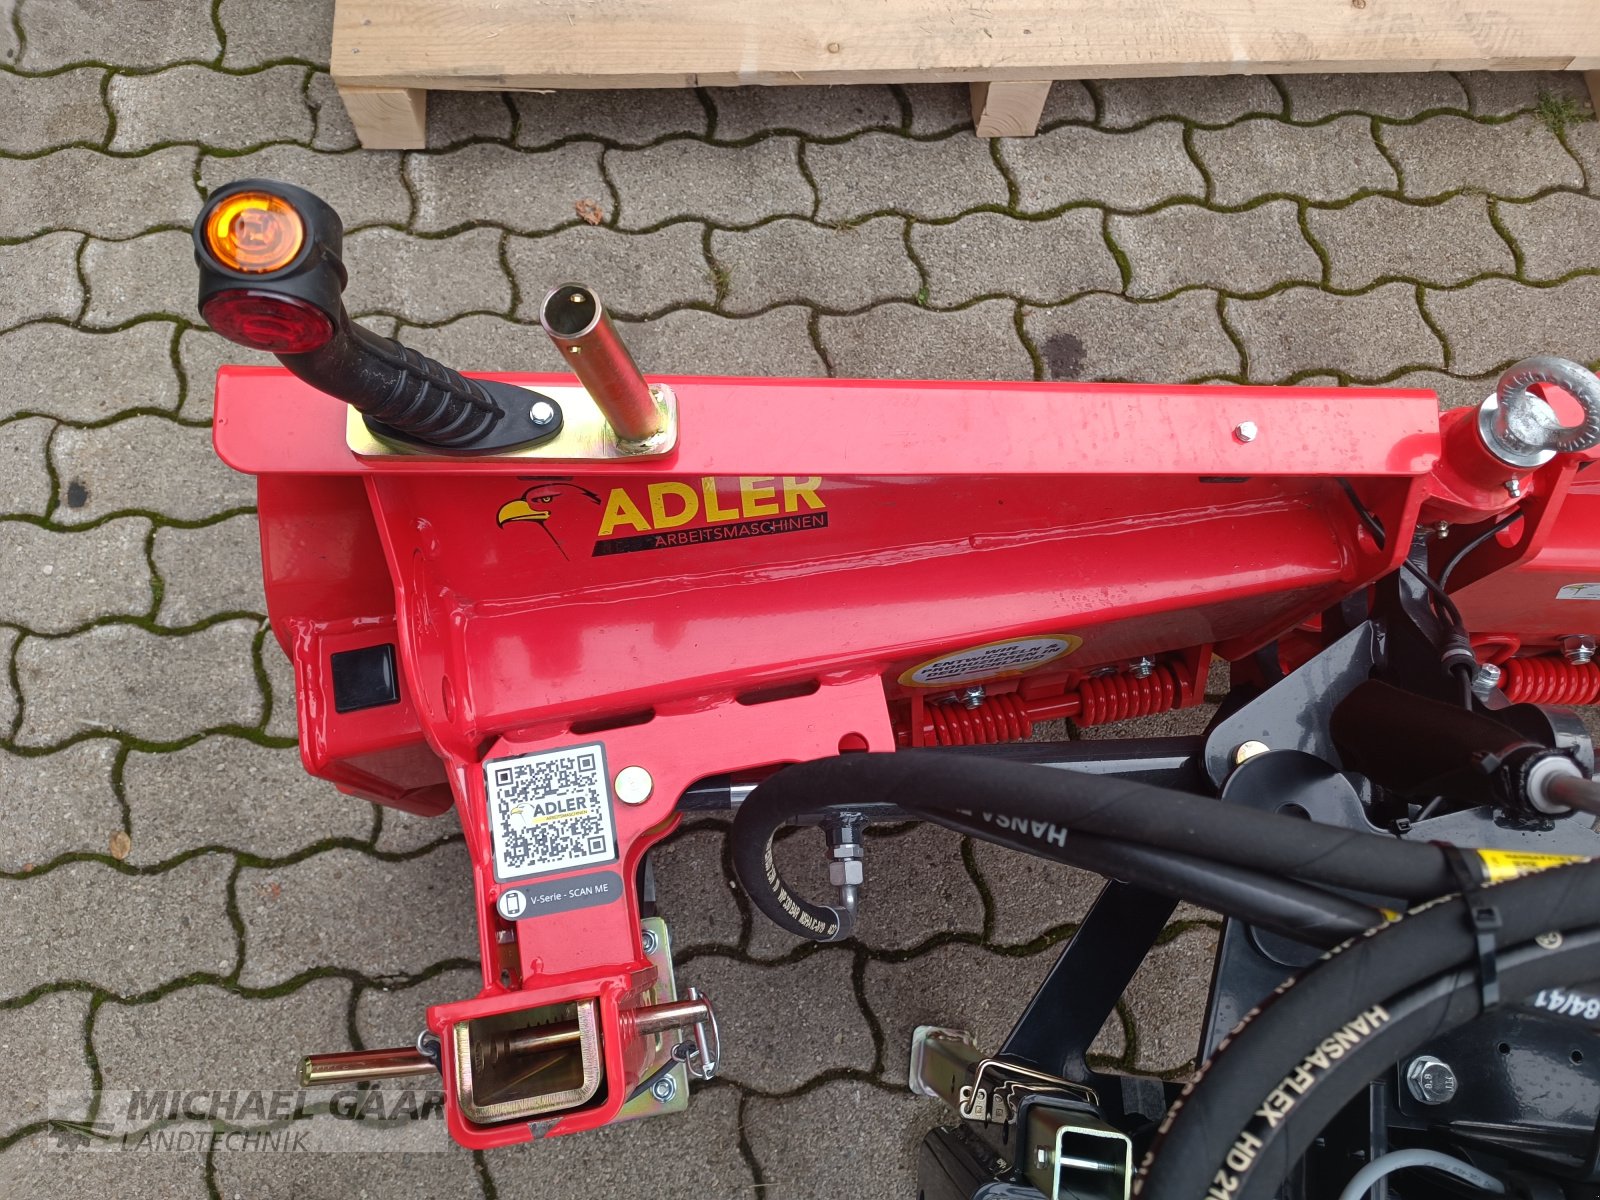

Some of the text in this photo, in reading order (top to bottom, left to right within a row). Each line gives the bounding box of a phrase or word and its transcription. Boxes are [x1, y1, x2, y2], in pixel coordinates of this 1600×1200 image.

[598, 477, 826, 537] ADLER
[655, 514, 825, 548] ARBEITSMASCHINEN
[533, 796, 587, 818] ADLER
[530, 889, 562, 906] V-Serie
[568, 886, 594, 899] SCAN
[594, 883, 609, 894] ME
[1255, 1004, 1390, 1128] HANSA-FLEX
[1225, 1131, 1263, 1173] HD
